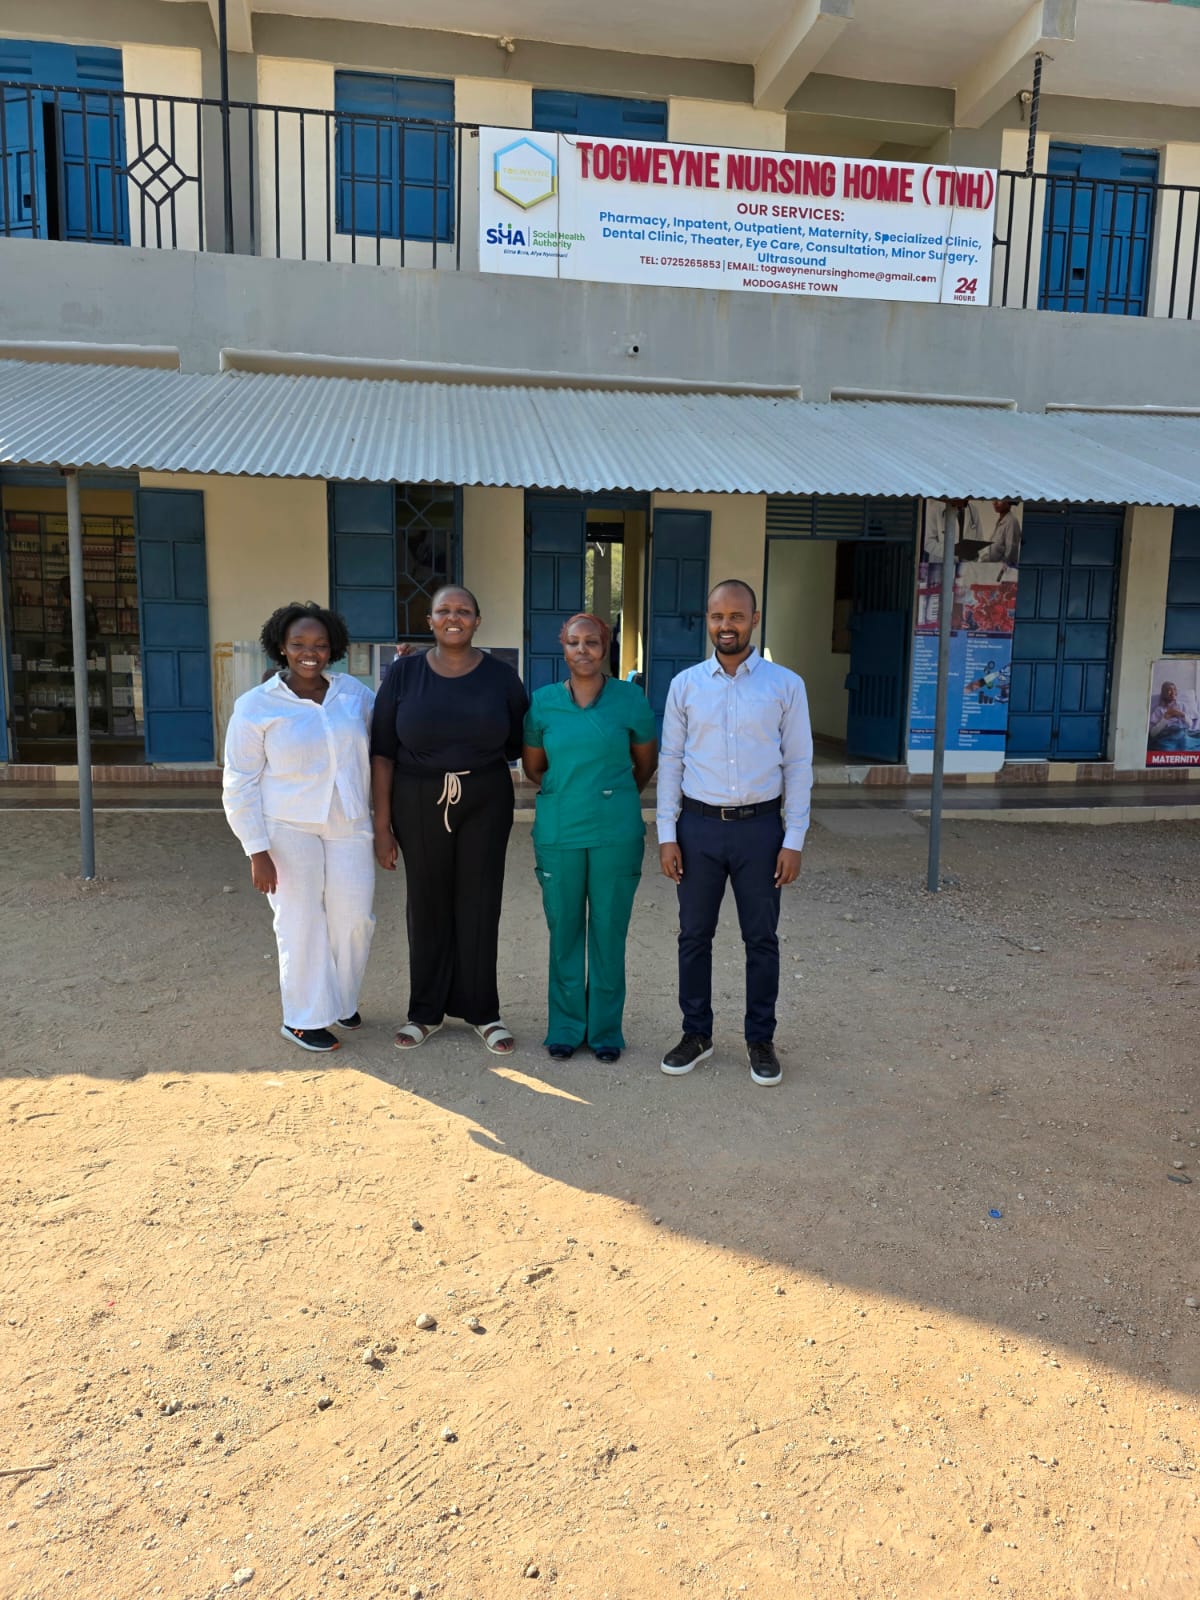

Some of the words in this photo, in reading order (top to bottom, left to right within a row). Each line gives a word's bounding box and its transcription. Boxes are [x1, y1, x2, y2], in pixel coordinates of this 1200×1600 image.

[576, 142, 720, 189] TOGWEYNE
[726, 154, 836, 197] NURSING
[843, 163, 914, 203] HOME
[922, 166, 994, 209] (TNH)
[737, 203, 767, 216] OUR
[771, 205, 845, 222] SERVICES:
[486, 222, 526, 246] SHA
[532, 230, 557, 239] Social
[559, 232, 586, 241] Health
[599, 211, 670, 229] Pharmacy,
[674, 217, 731, 232] Inpatent,
[734, 221, 805, 238] Outpatient,
[808, 226, 872, 243] Maternity,
[874, 231, 942, 247] Specialized
[945, 236, 981, 250] Clinic,
[532, 239, 572, 250] Authority
[602, 227, 645, 240] Dental
[648, 230, 687, 245] Clinic,
[691, 233, 743, 249] Theater,
[745, 238, 768, 251] Eye
[770, 239, 803, 253] Care,
[806, 242, 888, 258] Consultation,
[891, 247, 926, 260] Minor
[929, 250, 978, 265] Surgery.
[757, 252, 826, 267] Ultrasound
[640, 255, 659, 265] TEL:
[660, 258, 721, 269] 0725265853
[727, 261, 759, 272] EMAIL:
[761, 264, 936, 283] togweynenursinghome@gmail.com
[743, 278, 805, 290] MODOGASHE
[808, 282, 838, 293] TOWN
[954, 277, 978, 294] 24
[953, 294, 976, 302] HOURS
[1152, 755, 1199, 764] MATERNITY
